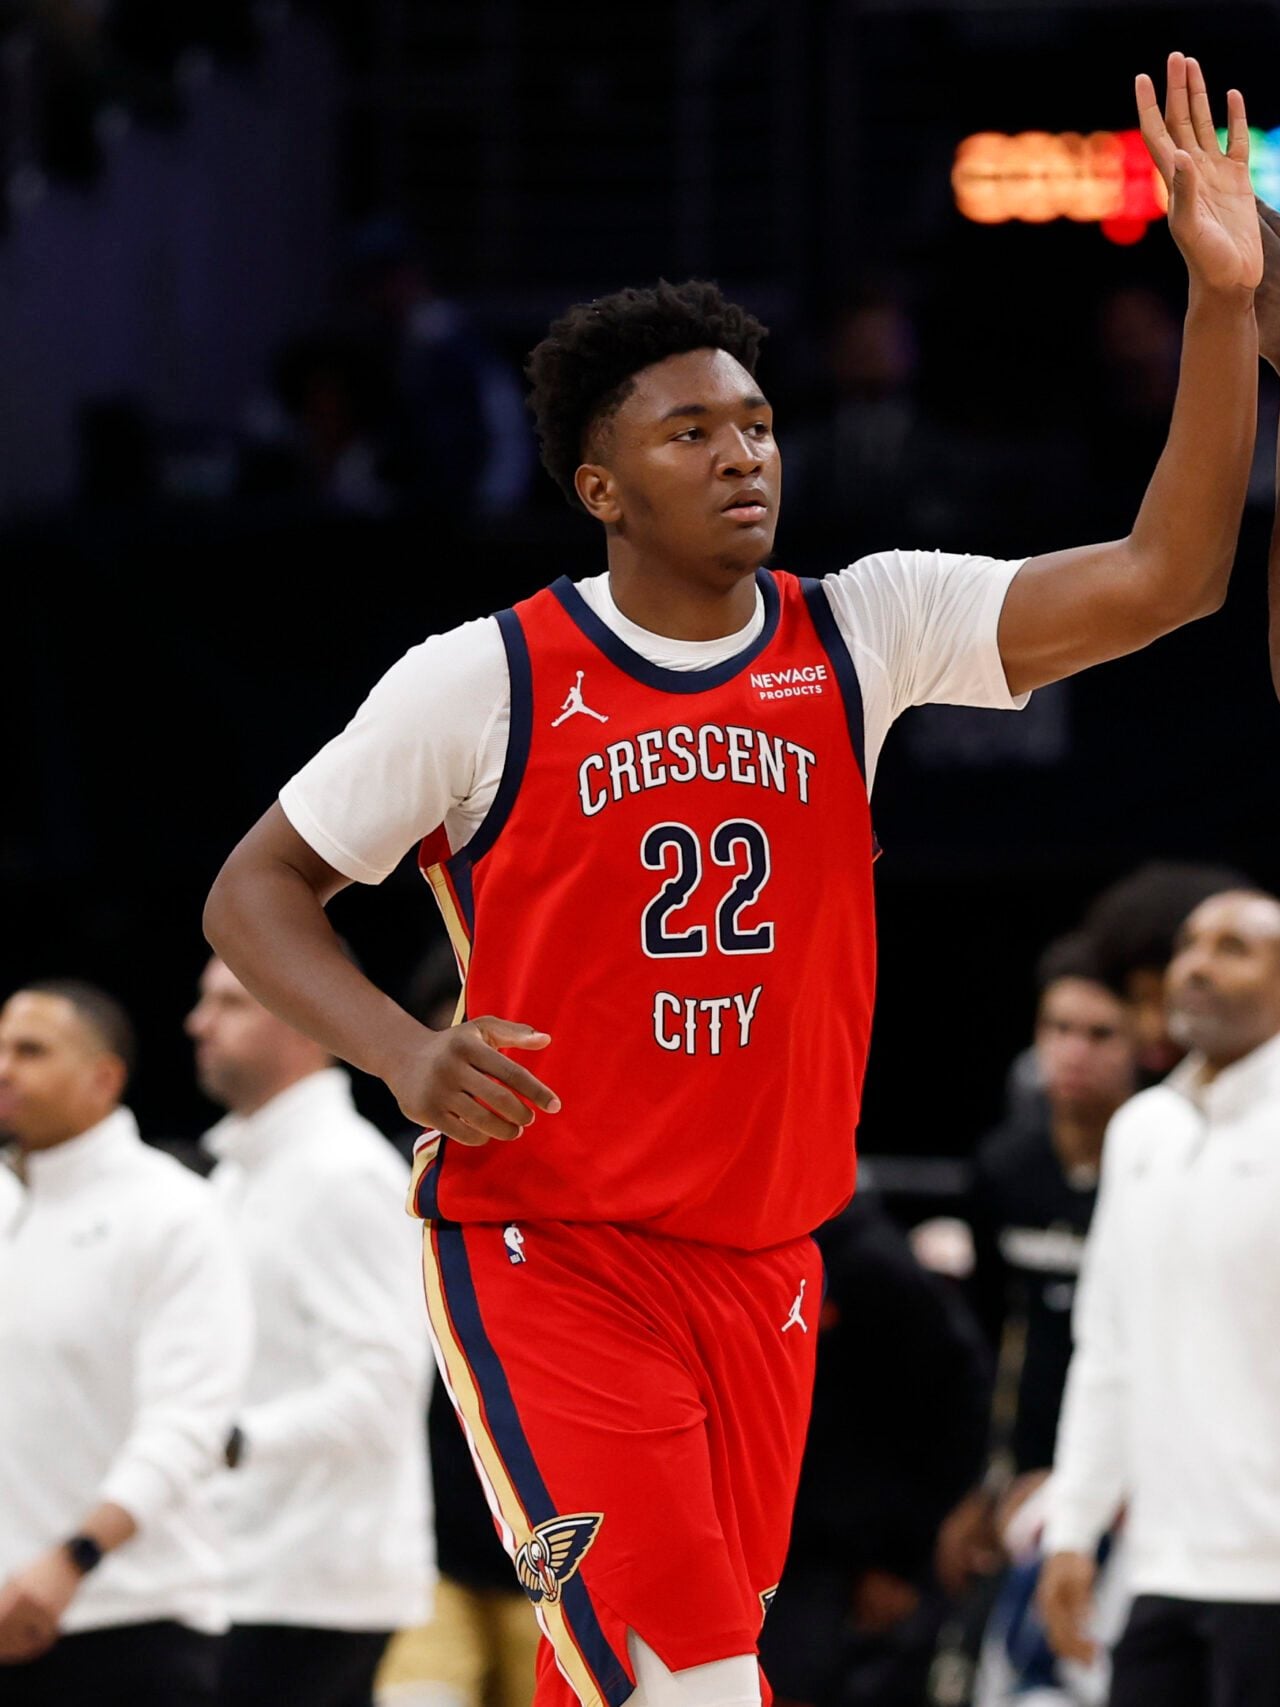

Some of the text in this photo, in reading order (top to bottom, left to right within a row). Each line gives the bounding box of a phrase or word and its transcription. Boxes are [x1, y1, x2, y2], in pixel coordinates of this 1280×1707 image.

[750, 665, 827, 688] NEWAGE
[759, 685, 822, 700] PRODUCTS
[578, 723, 816, 817] CRESCENT
[640, 817, 775, 959] 22
[652, 984, 763, 1055] CITY
